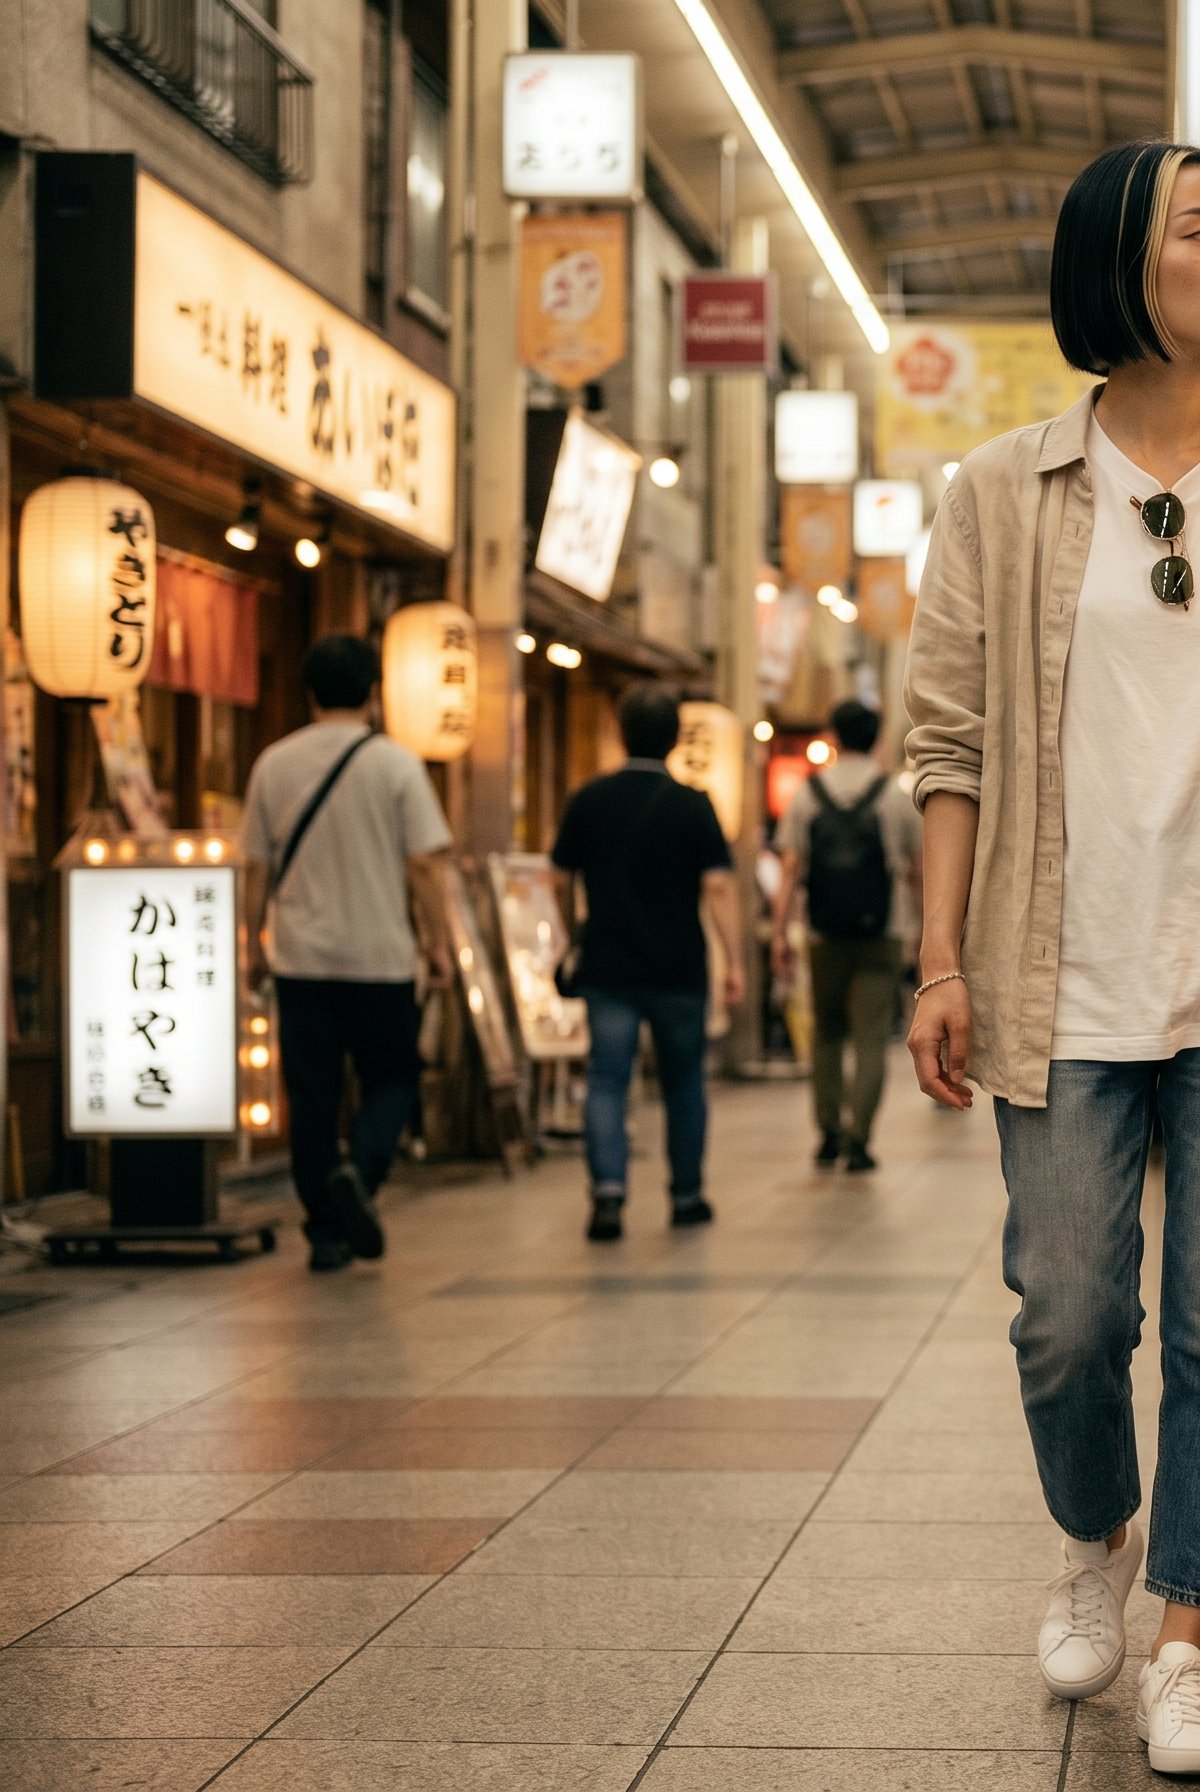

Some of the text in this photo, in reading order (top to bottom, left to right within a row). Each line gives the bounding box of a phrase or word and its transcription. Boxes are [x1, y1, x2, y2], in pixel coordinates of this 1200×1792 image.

[108, 507, 147, 670] やきとり
[129, 893, 178, 1109] かはやき
